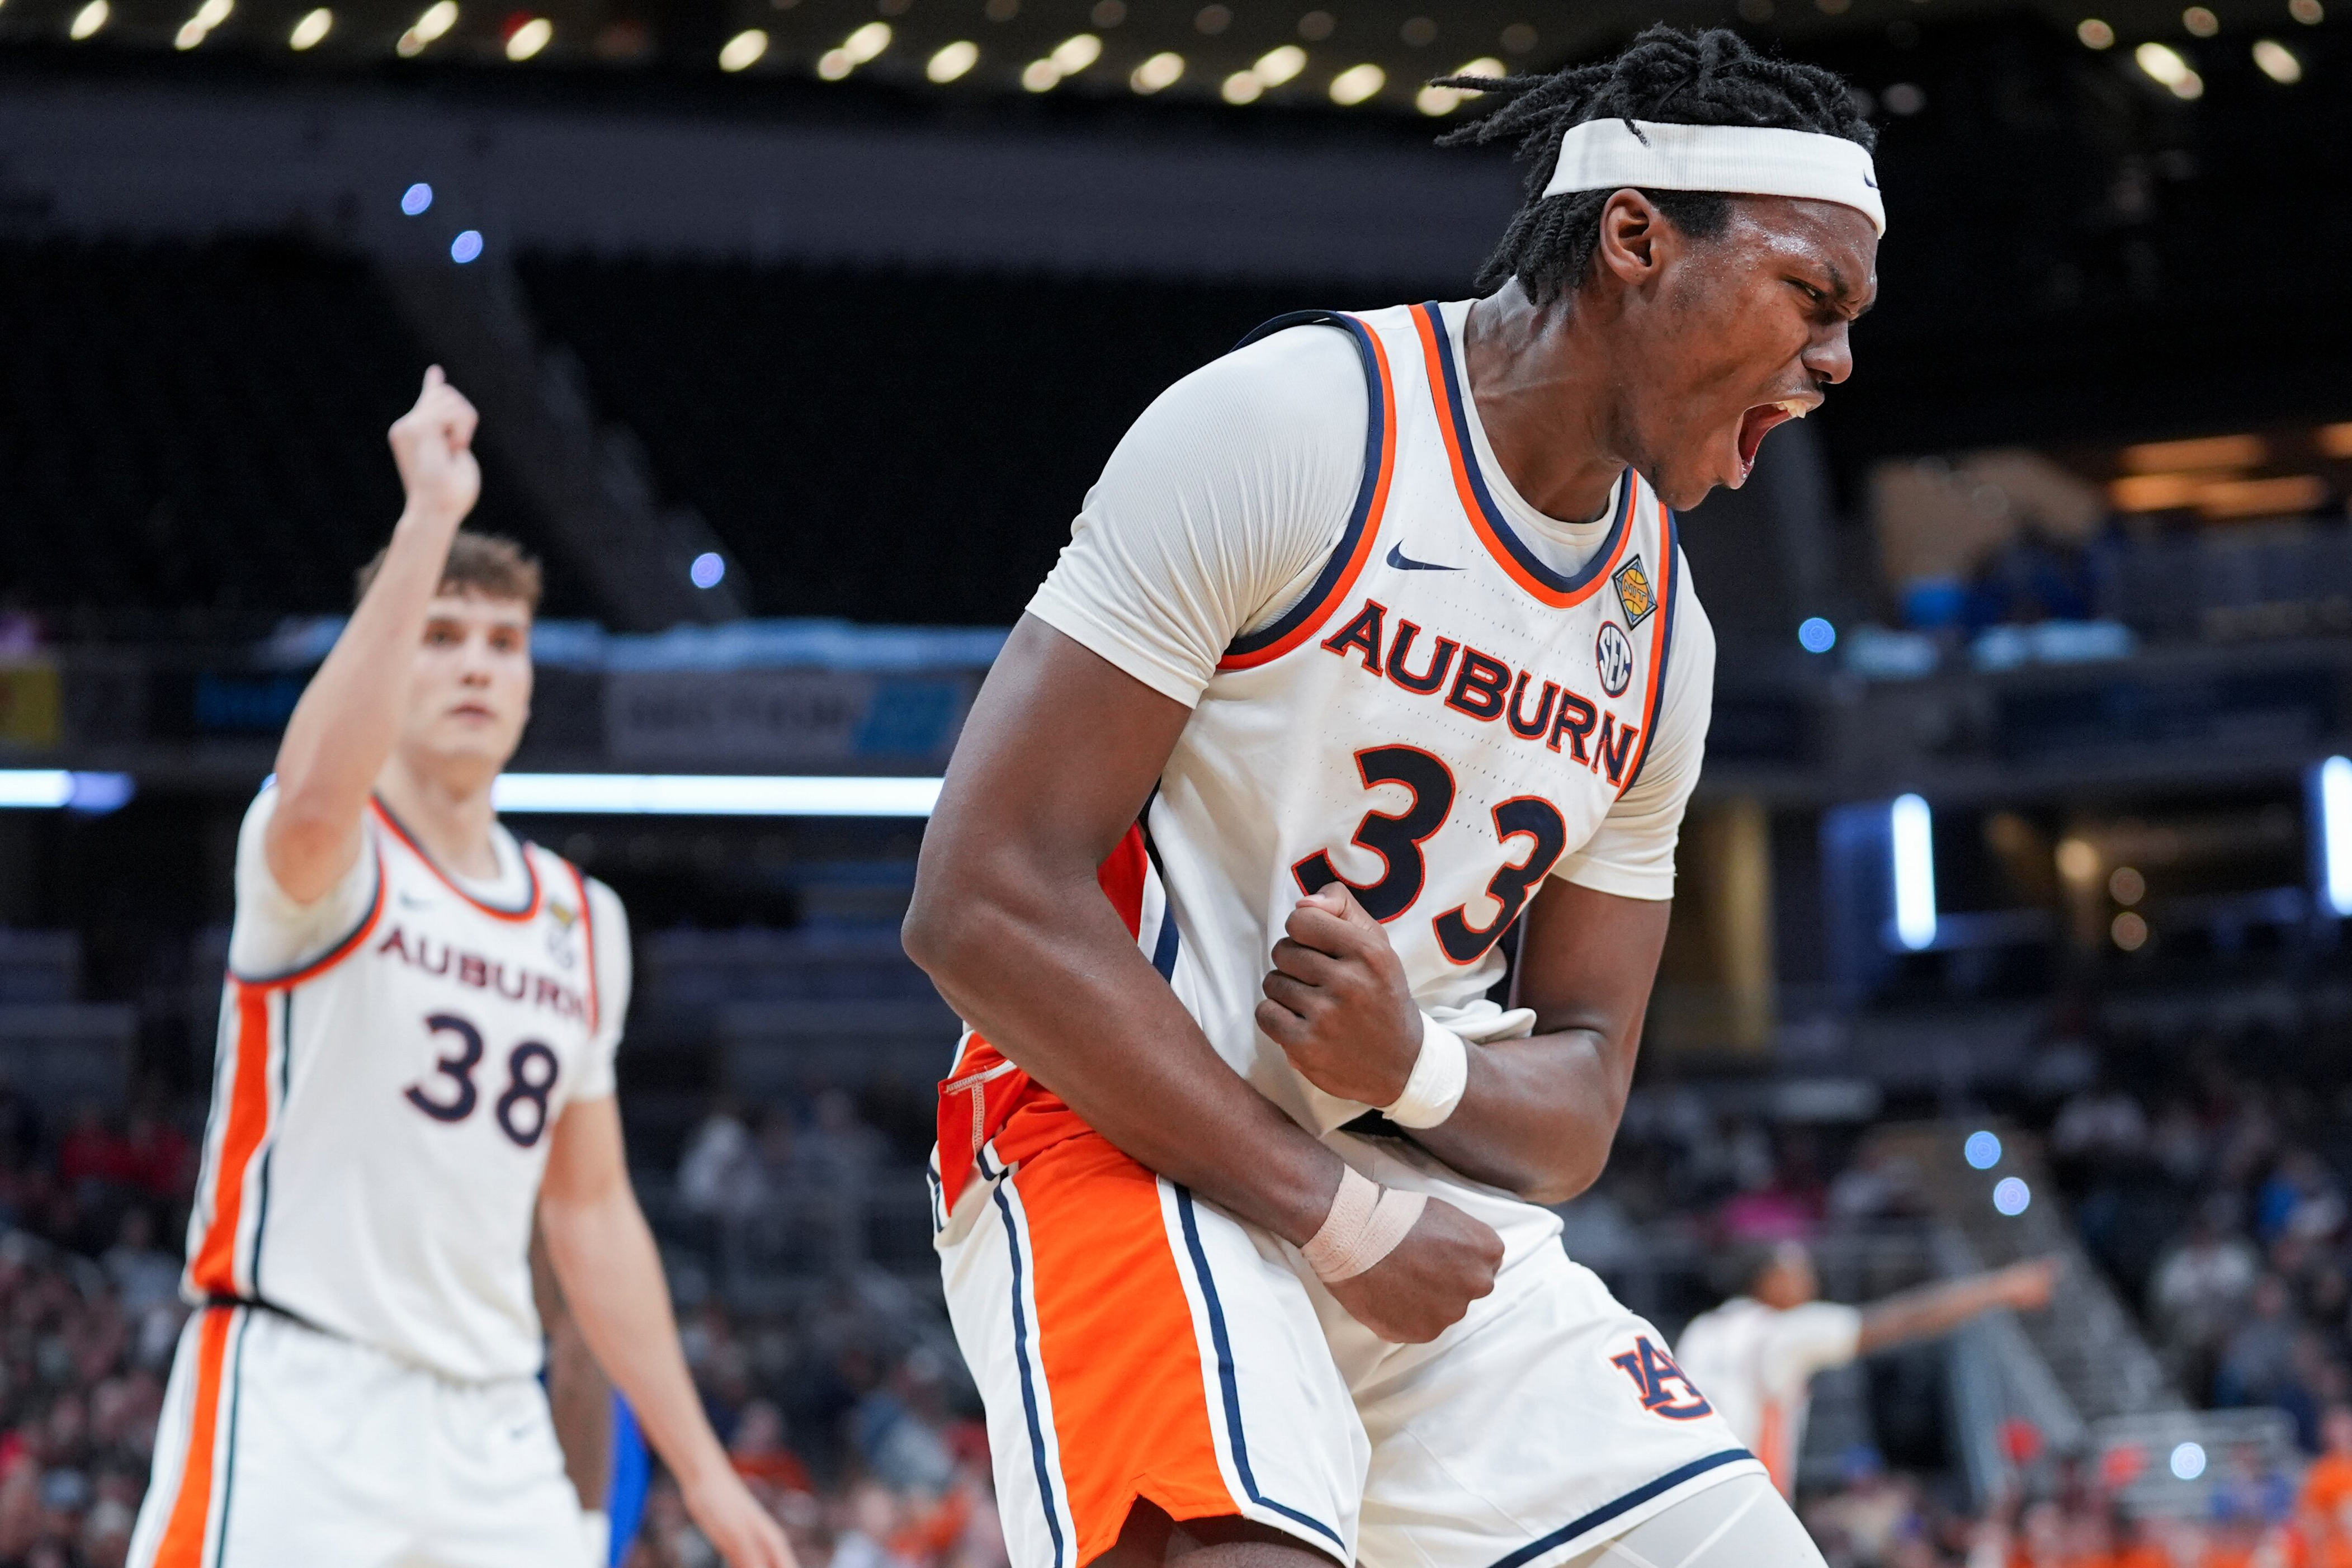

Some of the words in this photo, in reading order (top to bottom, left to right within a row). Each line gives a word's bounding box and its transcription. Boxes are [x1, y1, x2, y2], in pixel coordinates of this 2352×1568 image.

[1598, 625, 1631, 692] SEC
[1623, 579, 1647, 603] NIT
[1321, 598, 1640, 788] AUBURN
[1291, 744, 1566, 965] 33
[403, 1012, 558, 1147] 38
